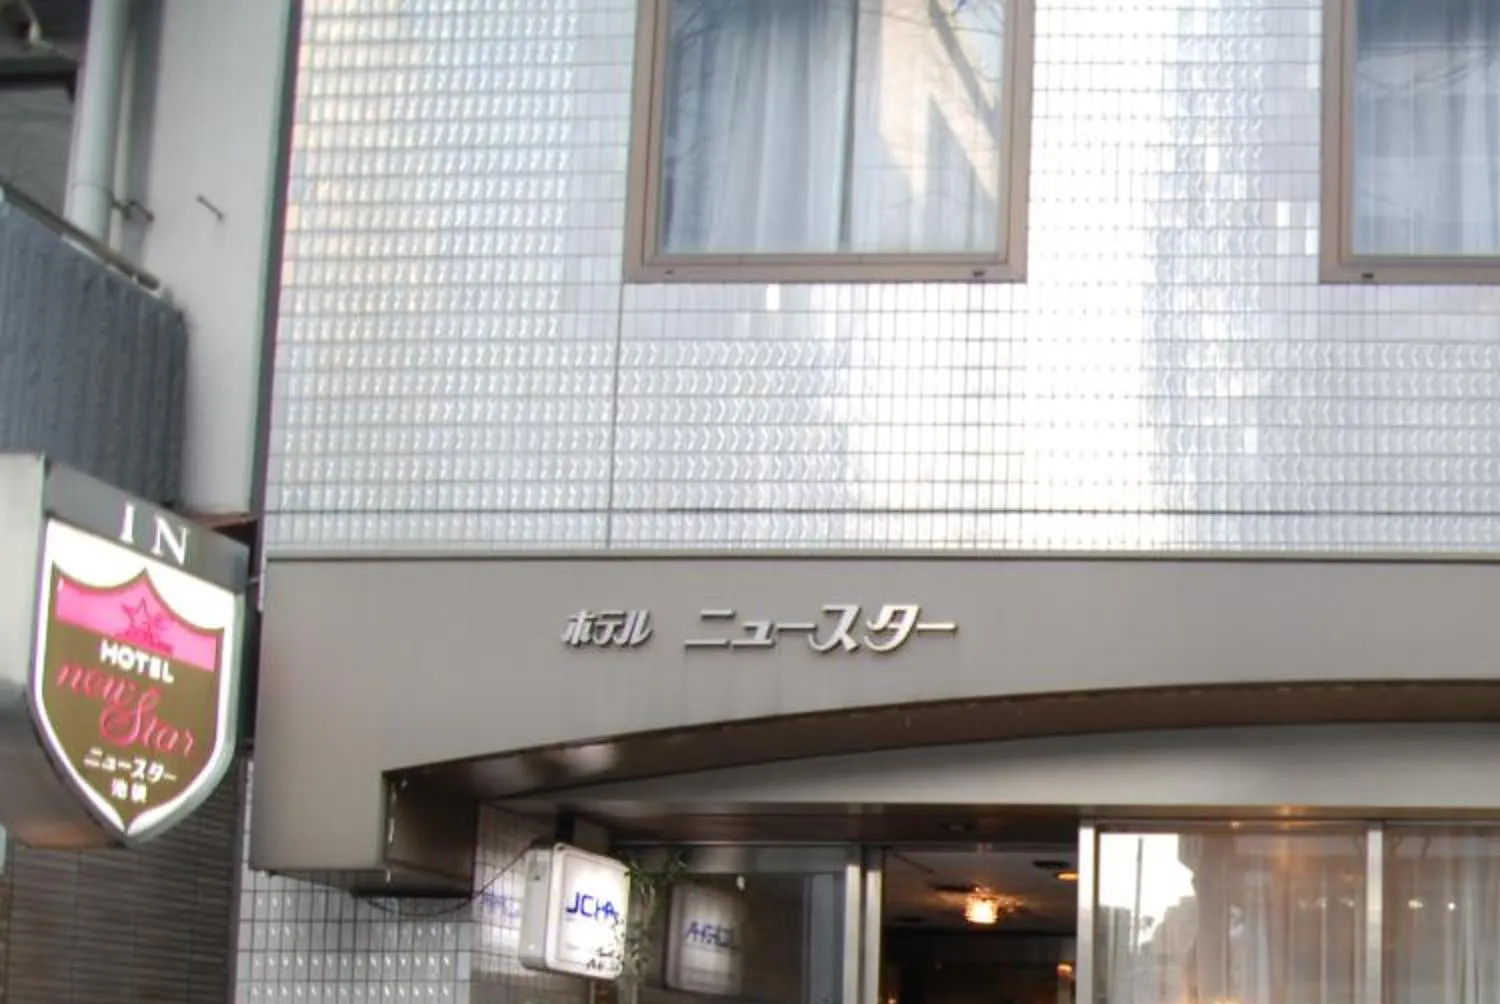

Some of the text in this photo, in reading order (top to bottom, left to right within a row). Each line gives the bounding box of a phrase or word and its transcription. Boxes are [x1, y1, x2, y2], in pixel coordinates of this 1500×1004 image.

[561, 603, 959, 654] ホテル ニュースター
[100, 638, 175, 684] HOTEL
[99, 686, 195, 758] Star
[83, 746, 179, 784] ニュースター
